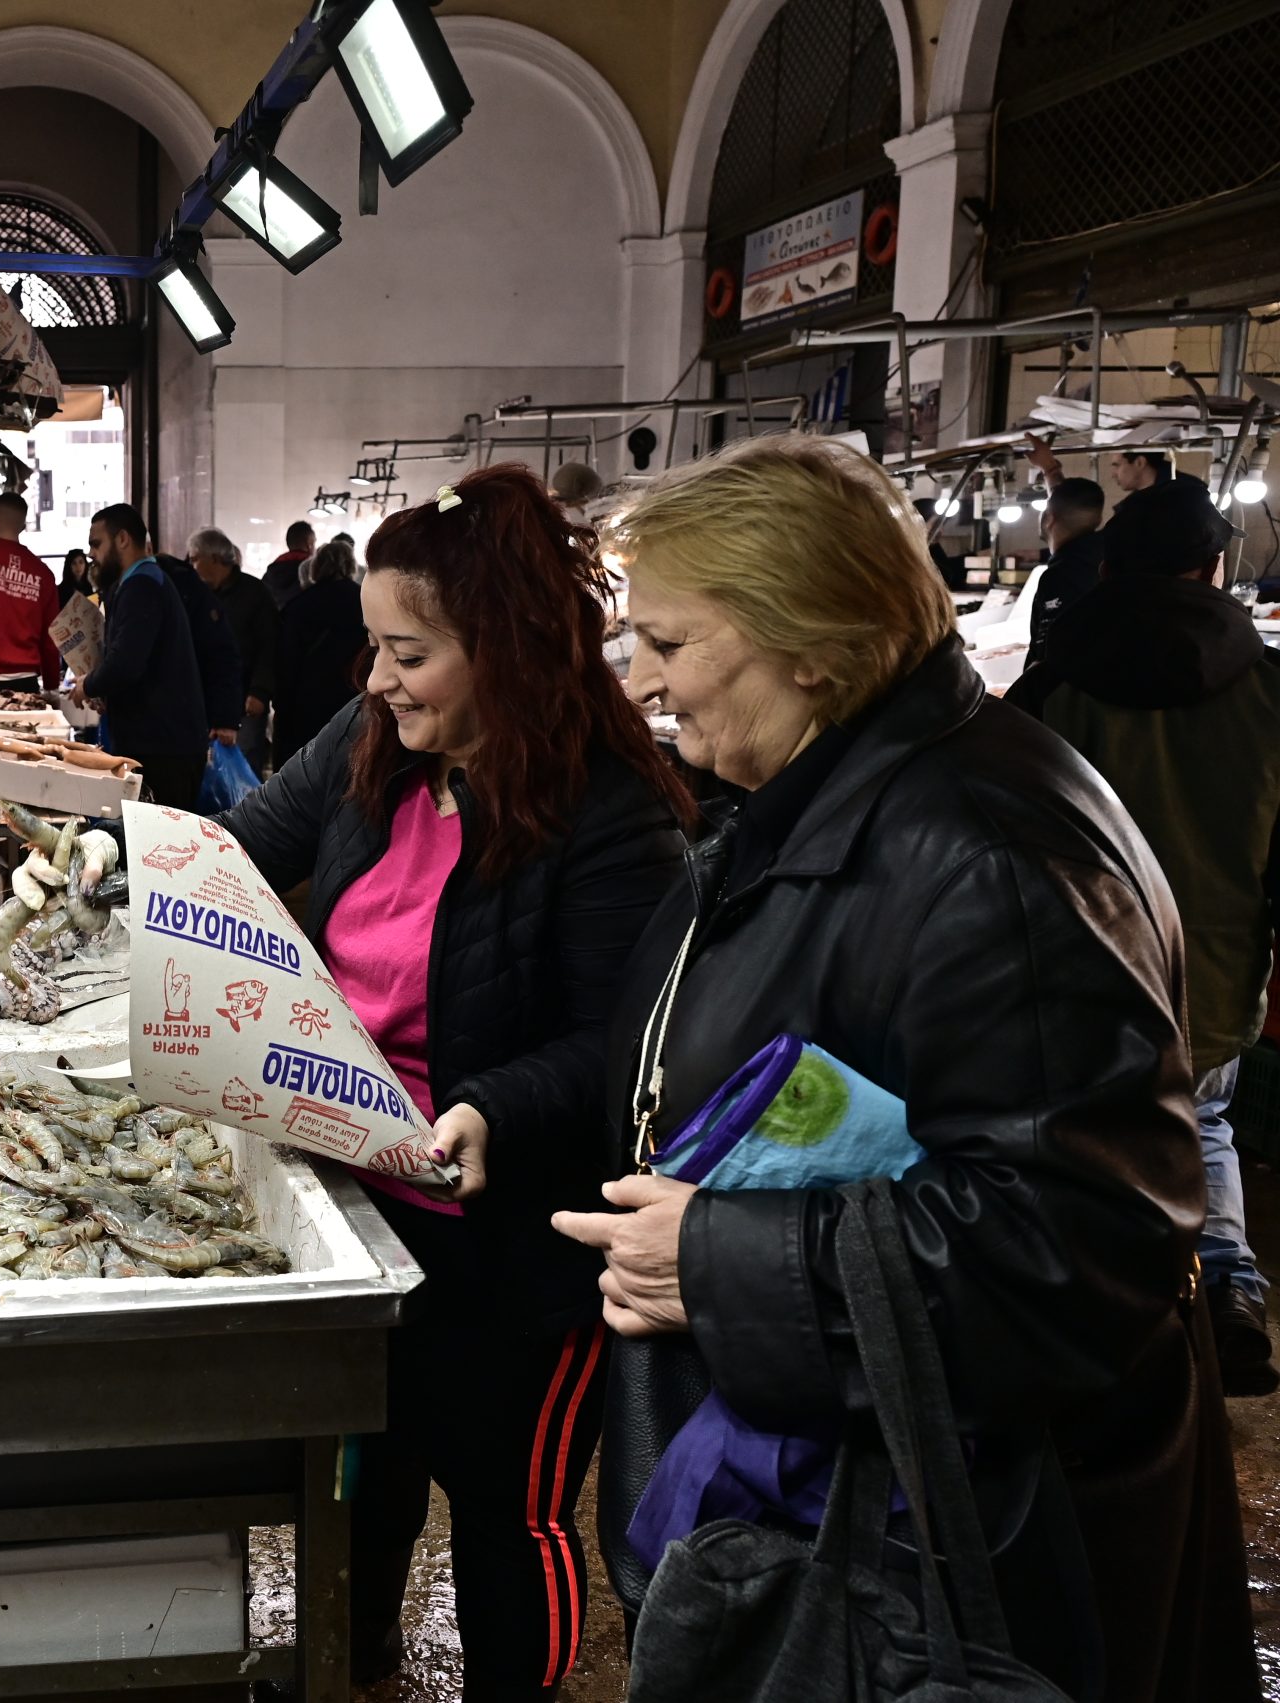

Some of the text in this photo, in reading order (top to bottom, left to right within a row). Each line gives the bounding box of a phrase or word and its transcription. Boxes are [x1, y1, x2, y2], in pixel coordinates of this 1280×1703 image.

[216, 867, 242, 885] ΨΑΡΙΑ
[145, 891, 301, 972] ΙΧΘΥΟΠΩΛΕΙΟ
[142, 1022, 211, 1038] ΕΚΛΕΚΤΑ
[152, 1040, 200, 1056] ΨΑΡΙΑ
